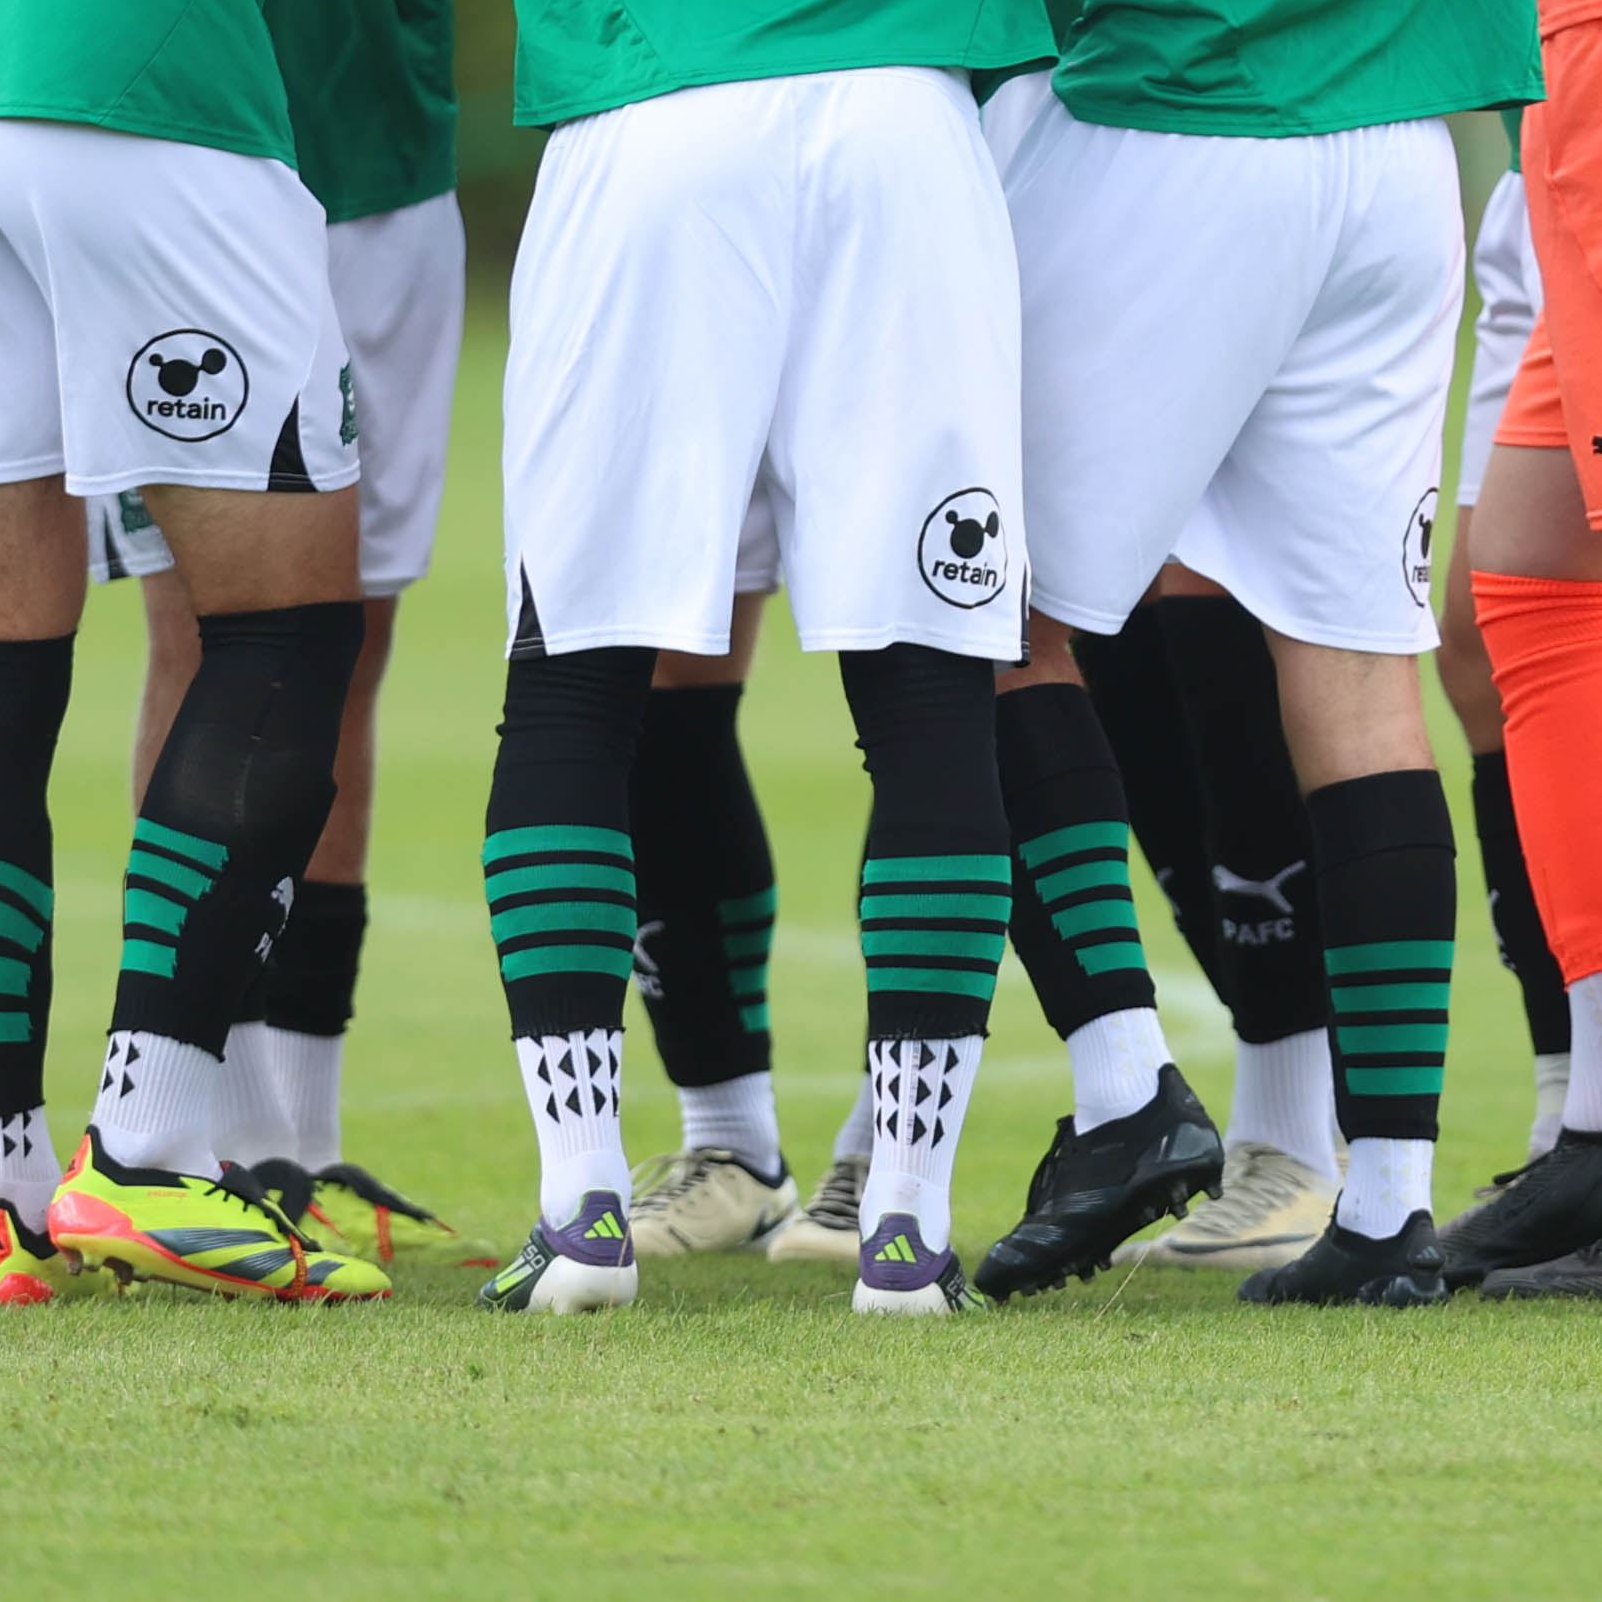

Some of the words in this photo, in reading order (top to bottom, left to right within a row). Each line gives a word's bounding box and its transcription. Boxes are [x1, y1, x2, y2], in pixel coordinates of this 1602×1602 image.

[146, 397, 227, 421] retain
[932, 559, 998, 588] retain
[1221, 917, 1295, 944] PAFC
